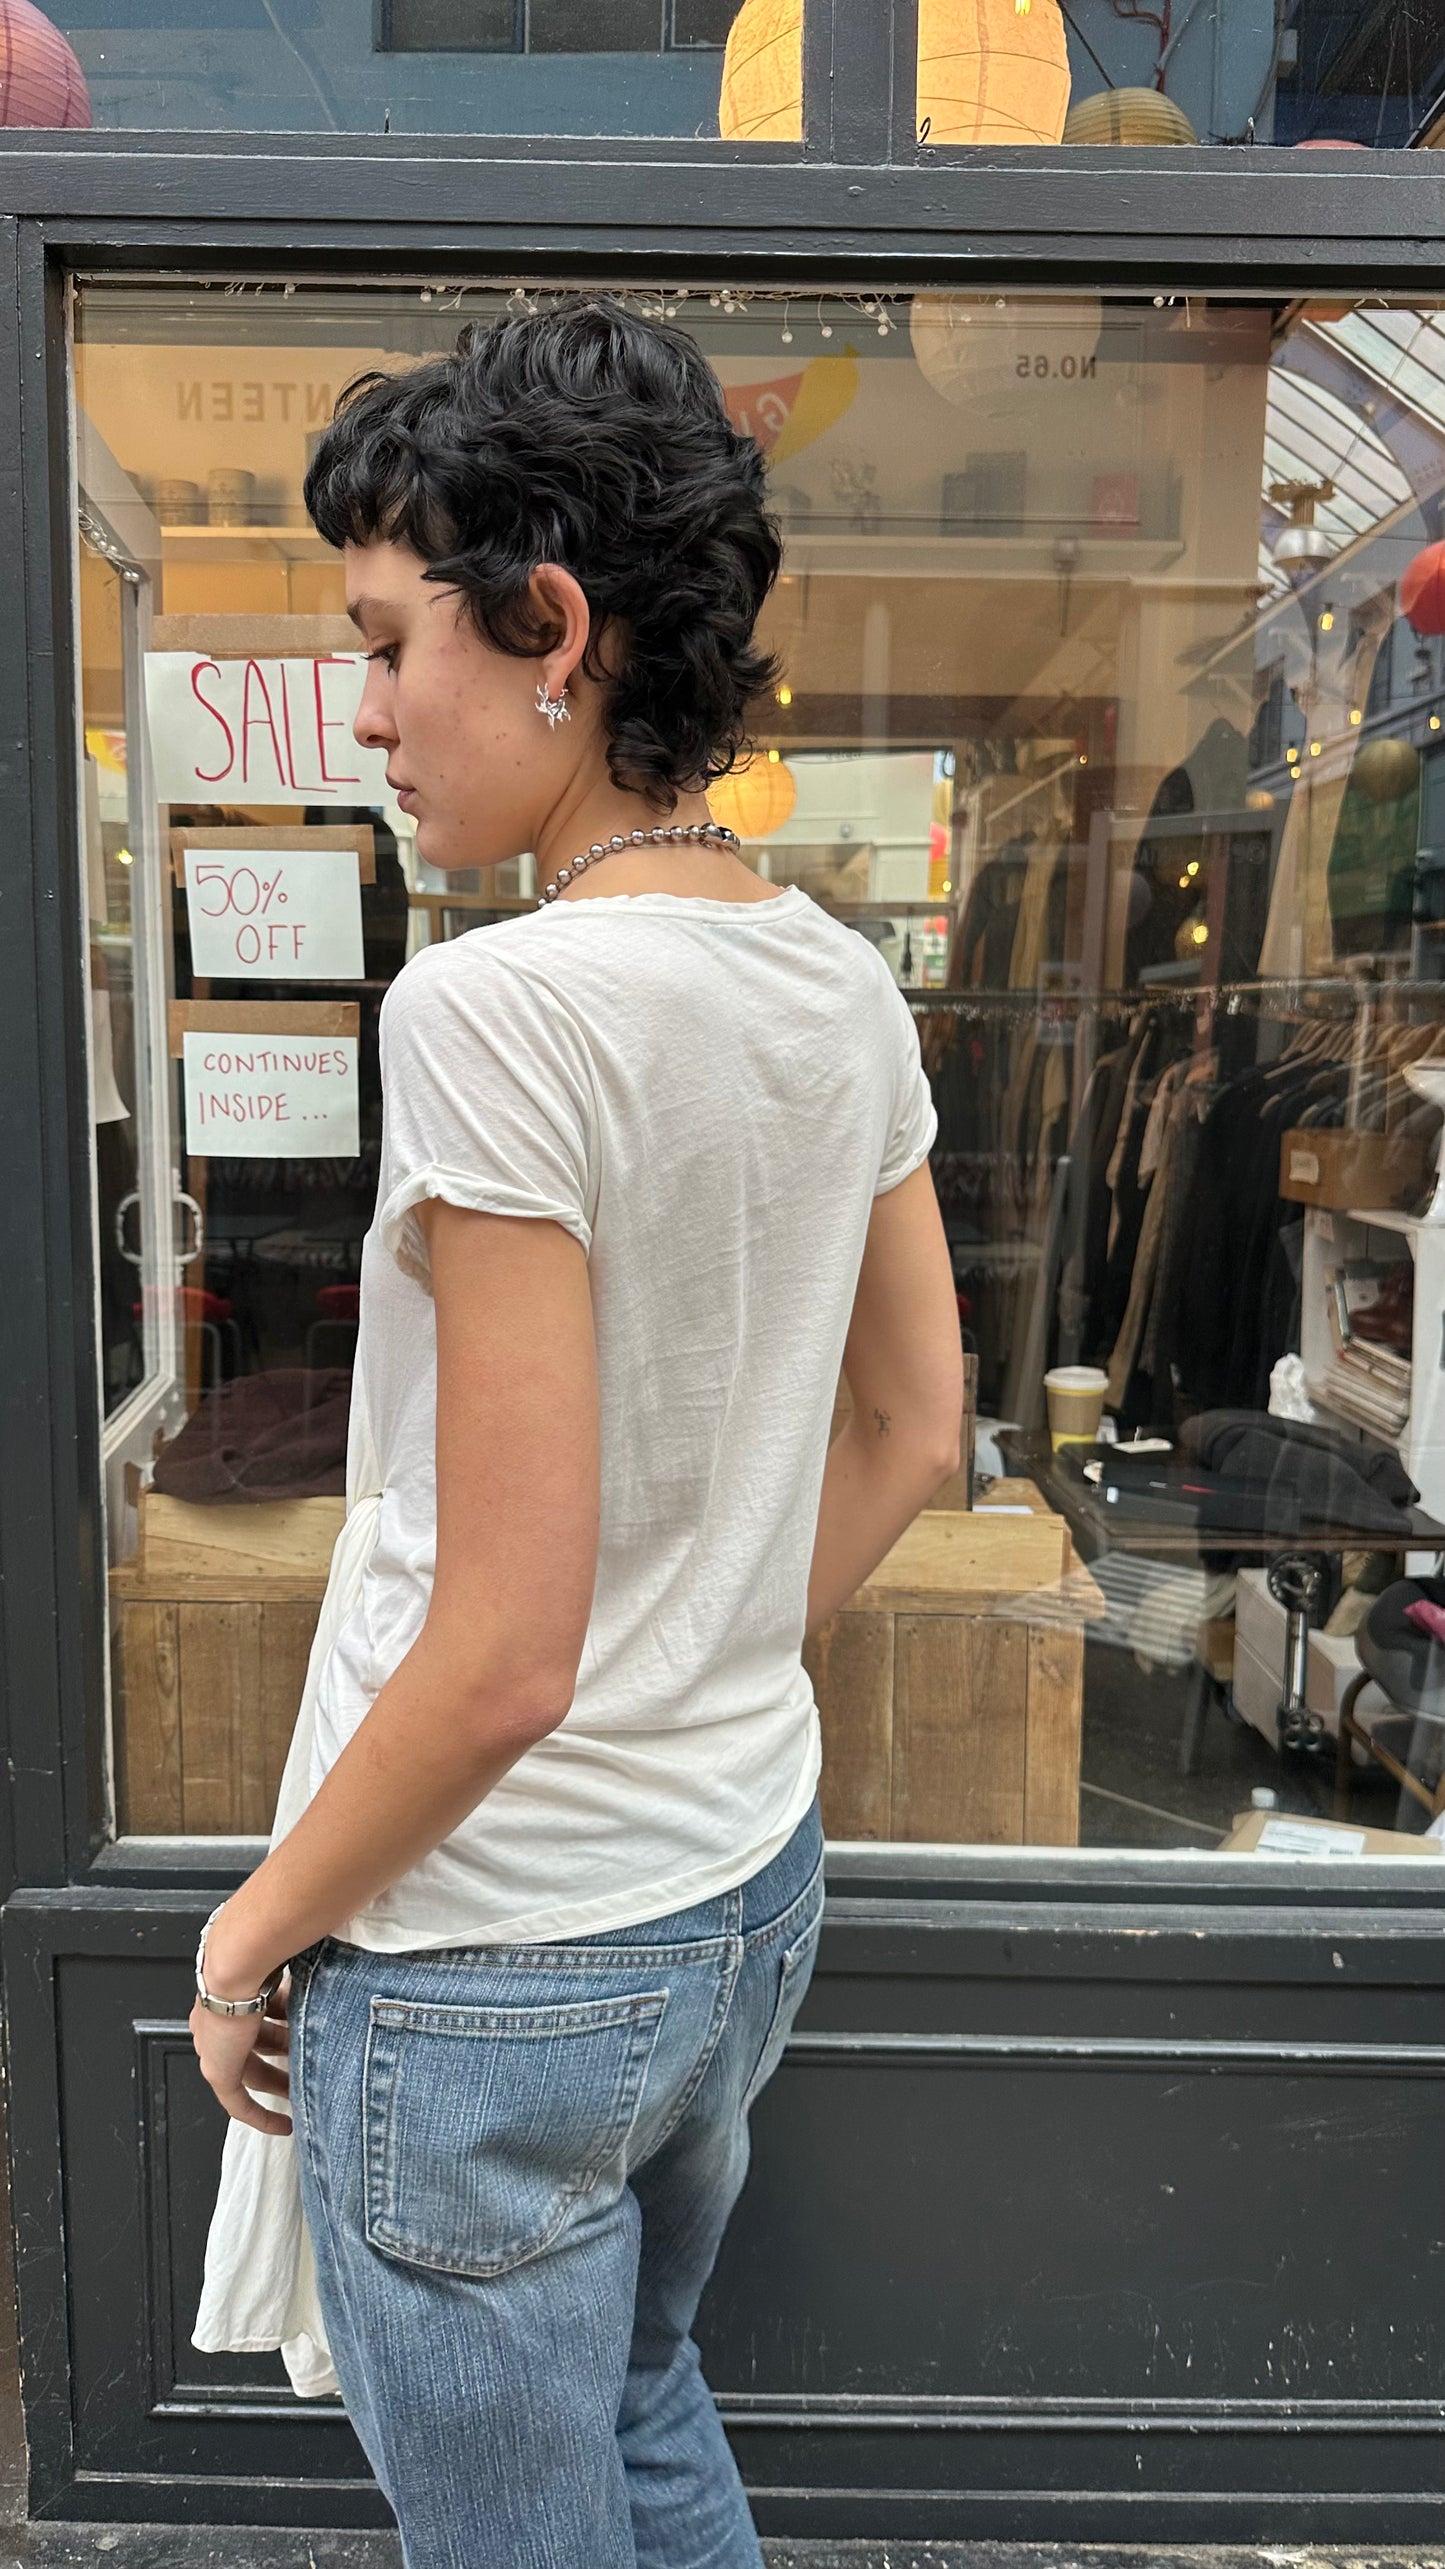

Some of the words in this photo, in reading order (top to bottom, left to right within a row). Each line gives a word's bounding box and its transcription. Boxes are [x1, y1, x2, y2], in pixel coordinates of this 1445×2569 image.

[191, 659, 361, 792] SALE
[196, 865, 288, 917] 50%
[236, 924, 306, 964] OFF
[204, 1050, 348, 1076] CONTINUES
